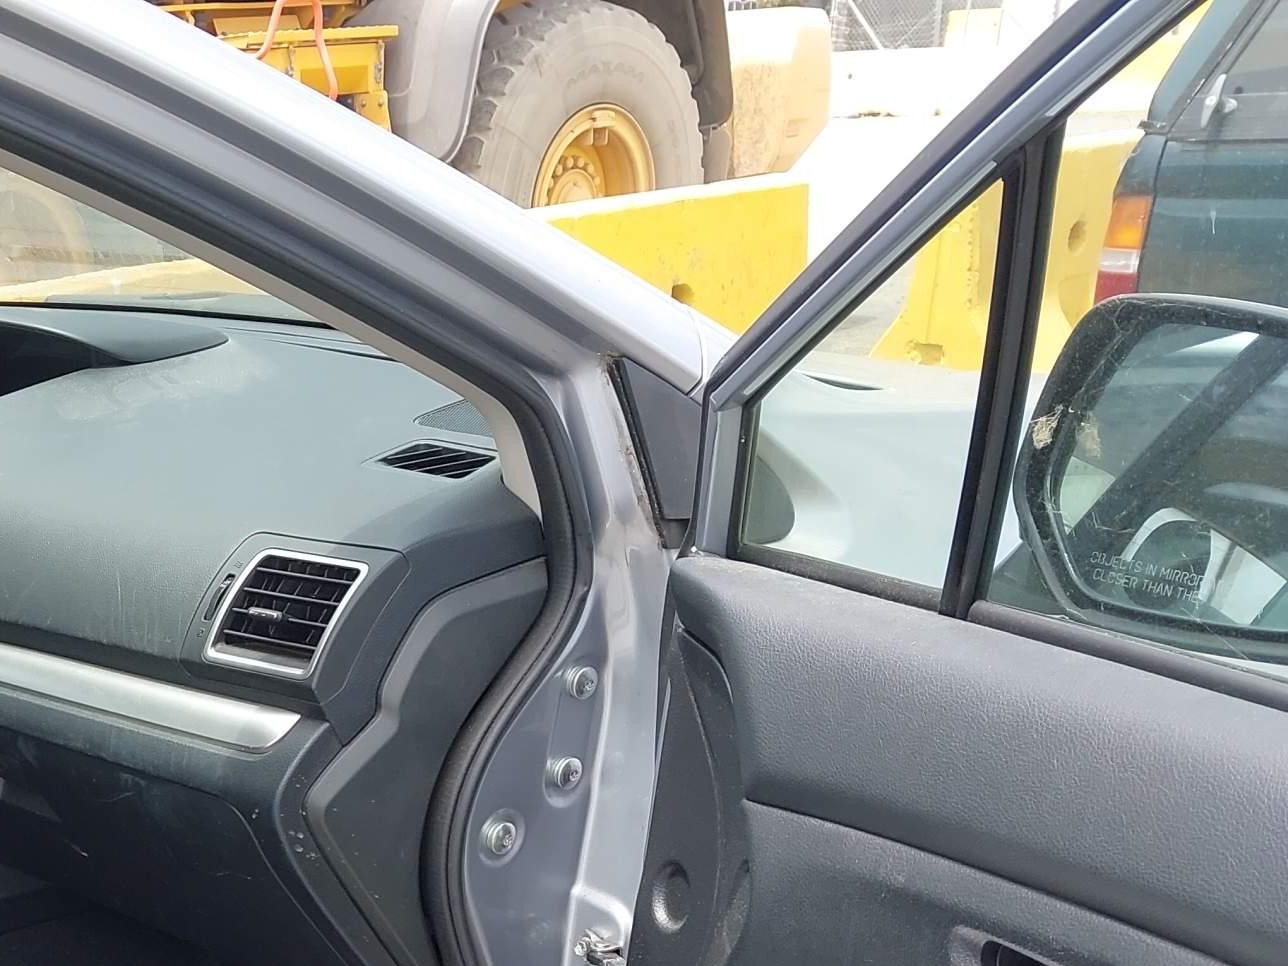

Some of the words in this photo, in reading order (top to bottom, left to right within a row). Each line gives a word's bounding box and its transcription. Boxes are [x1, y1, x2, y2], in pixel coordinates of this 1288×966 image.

[1090, 551, 1143, 573] OBJECTS
[1145, 562, 1158, 576] IN
[1092, 568, 1138, 589] CLOSER
[1142, 580, 1173, 598] THAN
